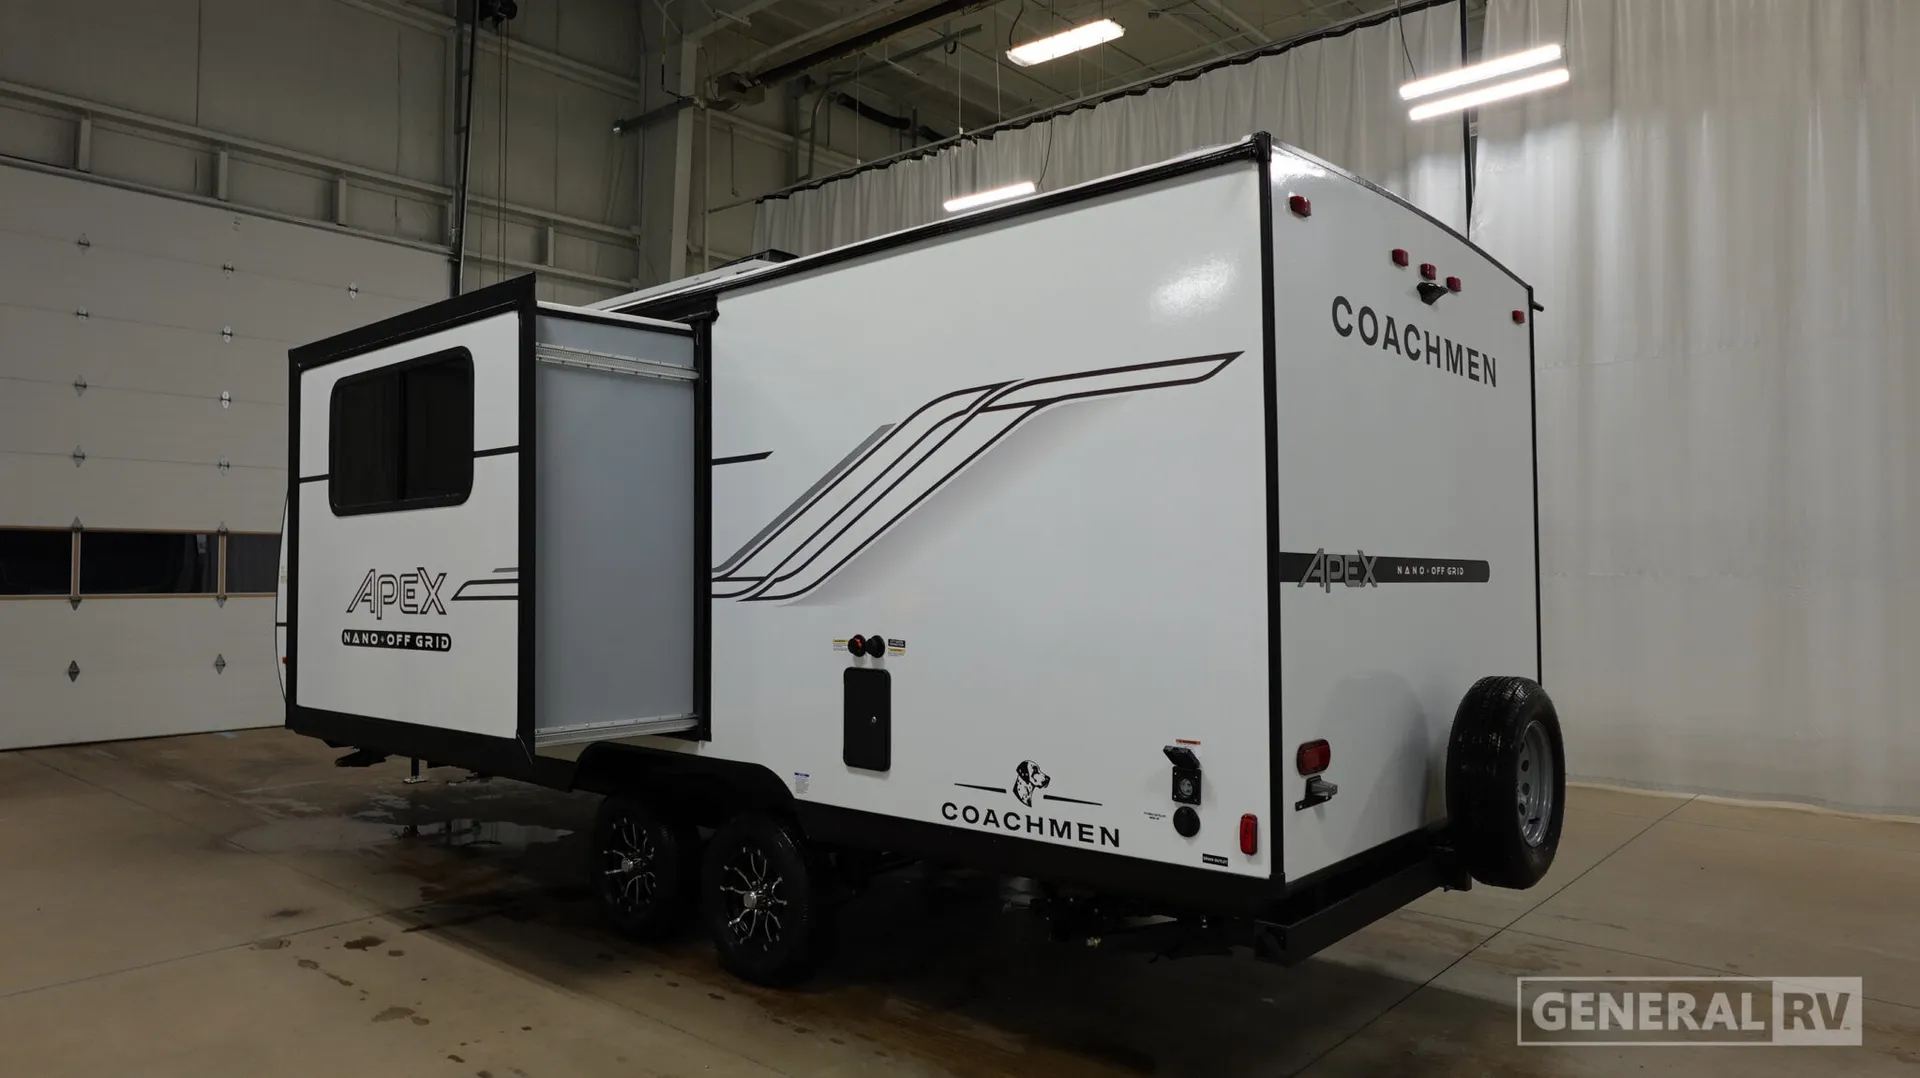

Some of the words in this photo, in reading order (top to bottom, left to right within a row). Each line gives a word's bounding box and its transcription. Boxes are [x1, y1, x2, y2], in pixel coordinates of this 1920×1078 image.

[1331, 295, 1497, 388] COACHMEN
[346, 566, 448, 621] APEX
[1297, 547, 1379, 594] APEX
[1397, 565, 1425, 575] NANO
[1431, 566, 1445, 576] OFF
[1447, 566, 1464, 576] GRID
[343, 631, 379, 645] NANO
[386, 633, 412, 647] OFF
[415, 635, 450, 649] GRID
[941, 801, 1120, 848] COACHMEN
